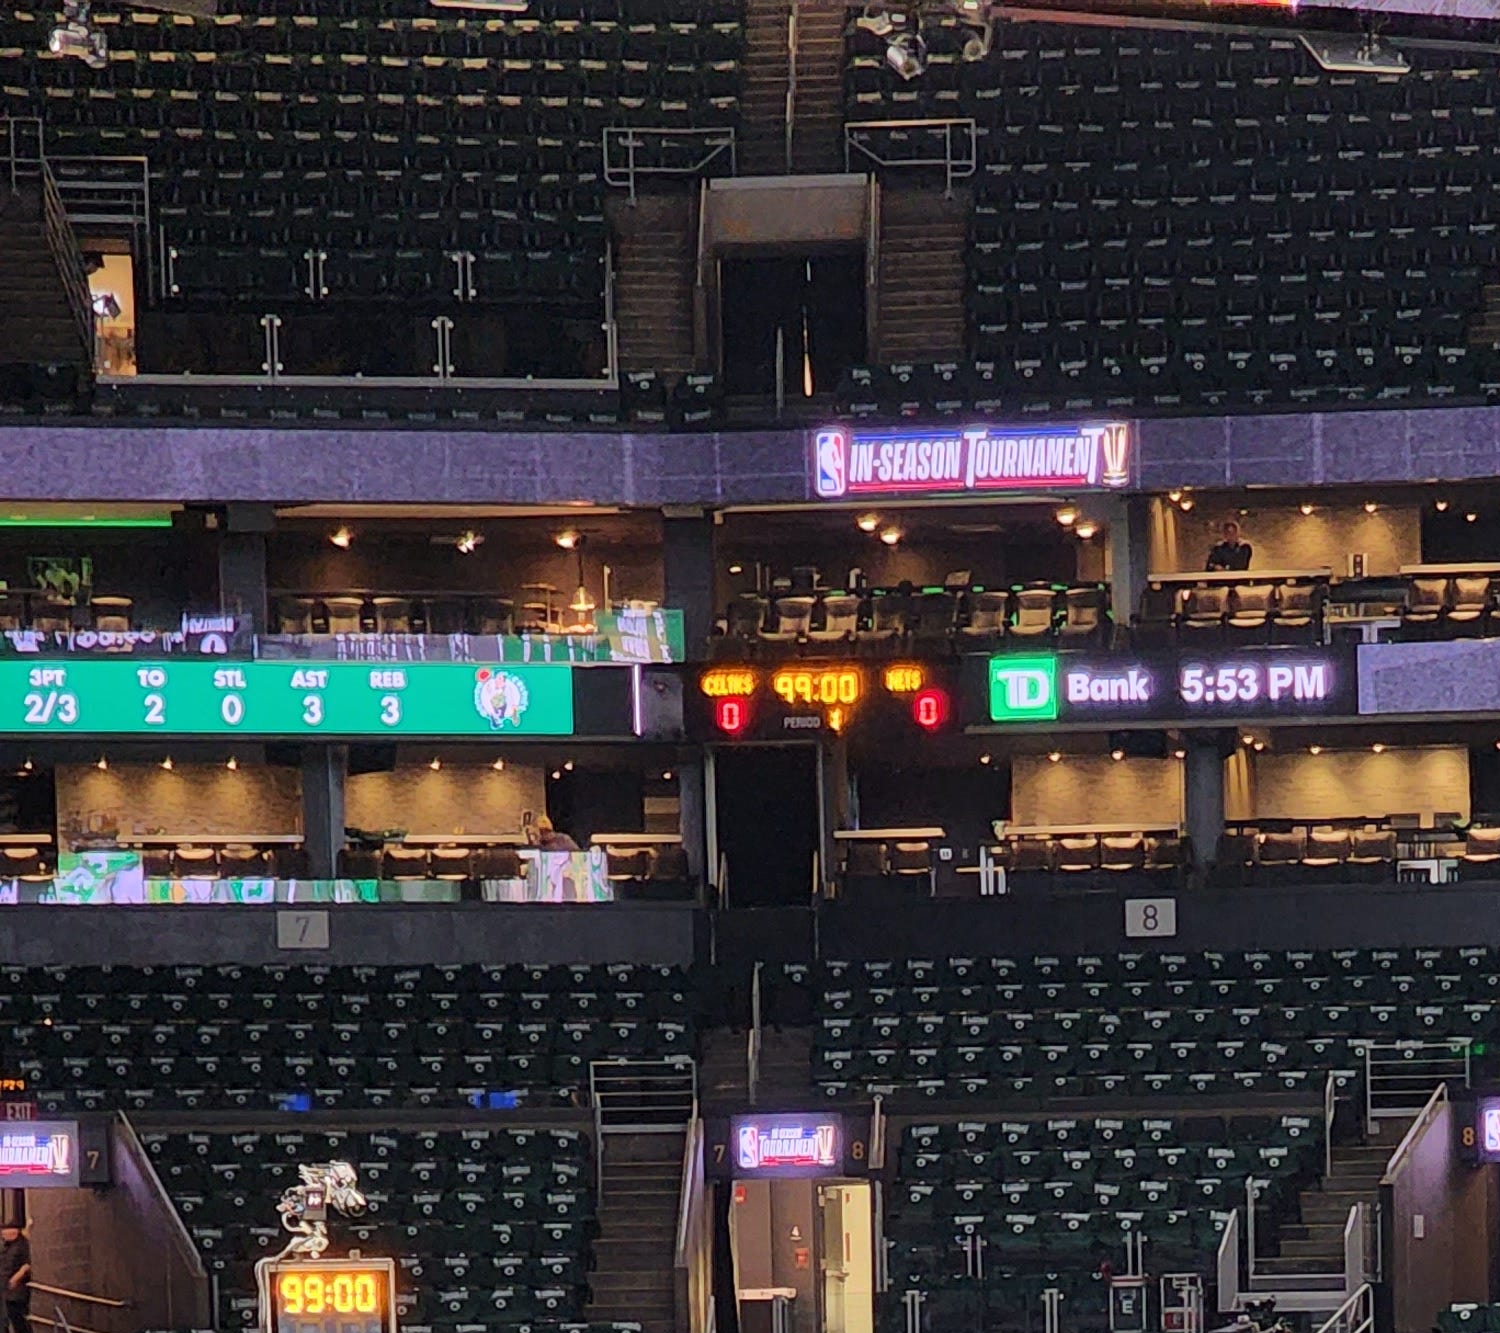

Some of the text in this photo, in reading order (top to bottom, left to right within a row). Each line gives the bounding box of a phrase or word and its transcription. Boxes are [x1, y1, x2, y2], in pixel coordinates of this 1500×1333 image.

[850, 427, 1106, 487] IN-SEASON TOURNAMENT
[29, 669, 66, 687] 3PT
[137, 669, 165, 687] TO
[213, 669, 247, 688] STL
[291, 669, 327, 688] AST
[370, 669, 406, 688] REB
[775, 673, 858, 704] 99:00
[886, 669, 922, 691] NETS
[996, 666, 1325, 709] TD Bank 5:53 PM
[24, 690, 78, 724] 2/3
[144, 693, 165, 724] 2
[221, 694, 243, 724] 0
[303, 695, 324, 726] 3
[380, 695, 402, 726] 3
[721, 702, 740, 730] 0
[918, 697, 938, 725] 0
[294, 914, 311, 943] 7
[1142, 906, 1159, 932] 8
[759, 1135, 821, 1161] TOURNAMENT
[1463, 1126, 1474, 1146] 8
[86, 1150, 99, 1170] 7
[713, 1145, 725, 1164] 7
[852, 1140, 864, 1160] 8
[280, 1273, 377, 1313] 99:00
